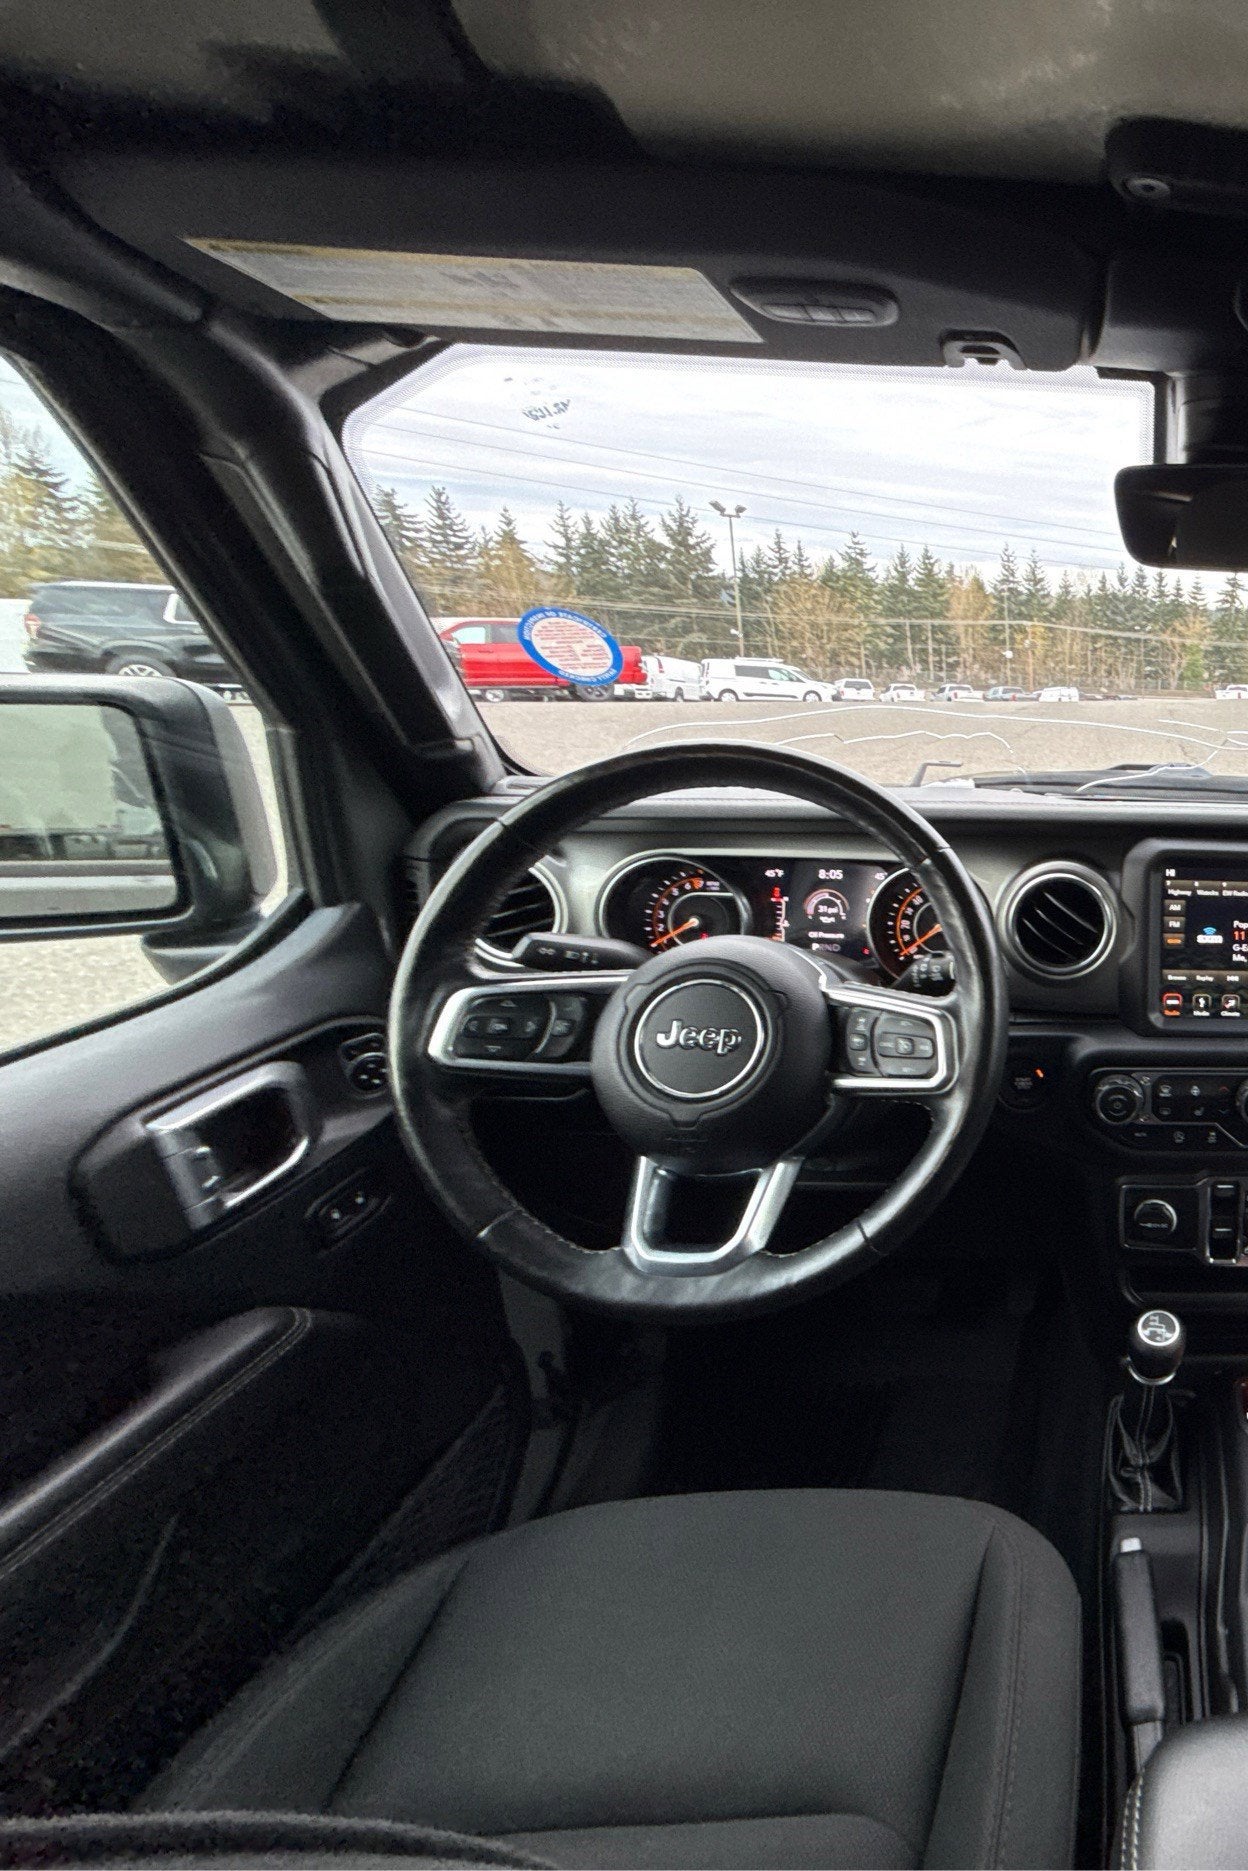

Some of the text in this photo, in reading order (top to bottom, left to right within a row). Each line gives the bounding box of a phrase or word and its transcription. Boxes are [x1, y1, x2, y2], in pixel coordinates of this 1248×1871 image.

[818, 868, 844, 880] 8:05
[1233, 930, 1245, 941] 11
[656, 1020, 742, 1055] Jeep
